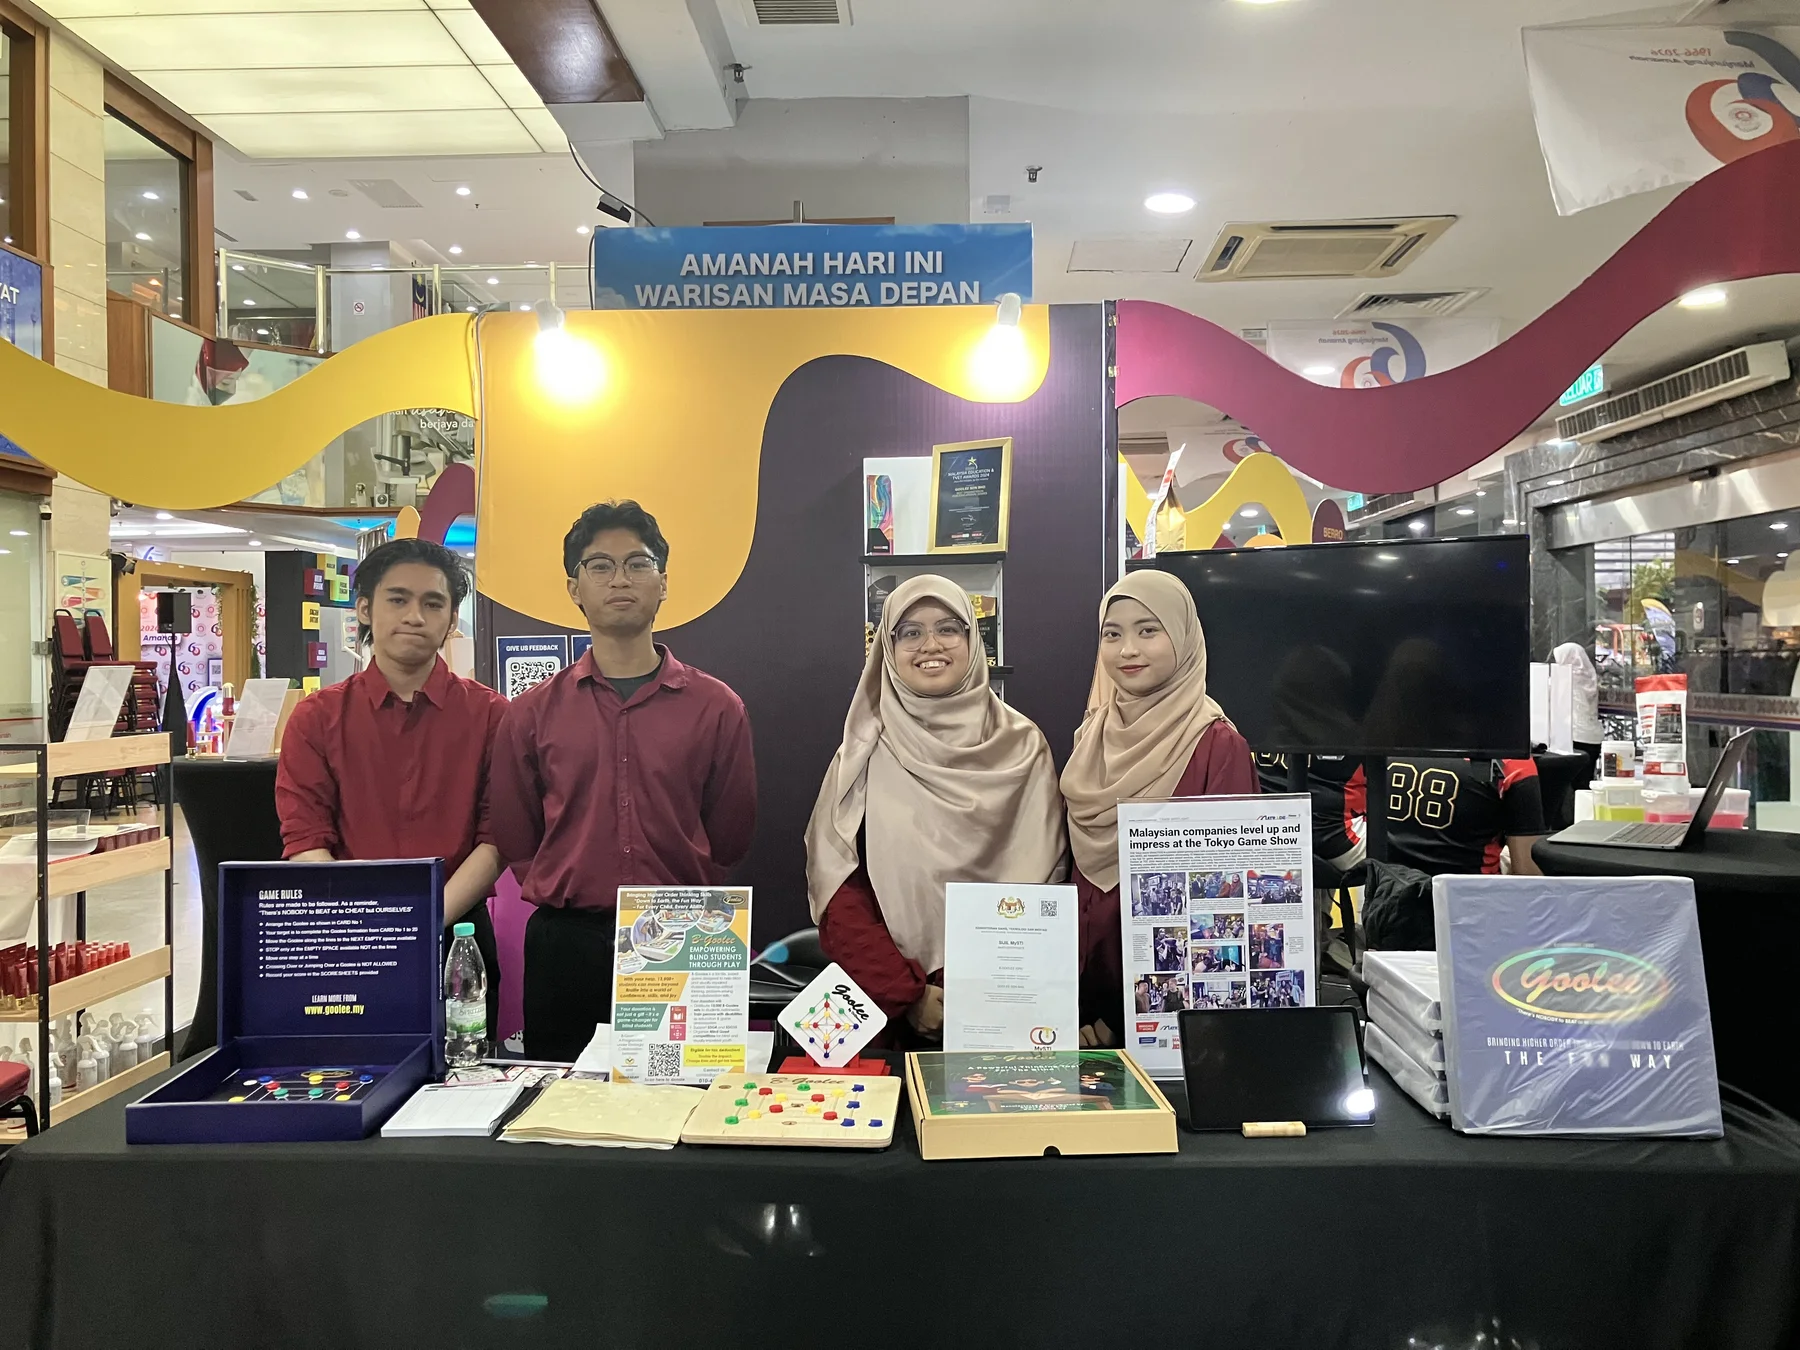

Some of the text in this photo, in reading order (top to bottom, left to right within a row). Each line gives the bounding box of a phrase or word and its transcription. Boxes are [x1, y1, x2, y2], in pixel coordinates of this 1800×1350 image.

[680, 251, 942, 276] AMANAH HARI INI
[635, 281, 980, 307] WARISAN MASA DEPAN
[420, 419, 458, 430] berjaya
[1387, 762, 1459, 829] 88
[1129, 824, 1300, 839] Malaysian companies level up and
[1130, 836, 1298, 850] impress at the Tokyo Game Show
[259, 890, 302, 899] GAME RULES
[312, 995, 327, 1003] LEARN
[343, 994, 356, 1002] FROM
[305, 1004, 364, 1015] www.goolee.my
[1487, 1037, 1520, 1047] BRINGING
[1522, 1038, 1547, 1048] HIGHER
[1505, 1051, 1543, 1065] THE
[1630, 1054, 1670, 1069] WAY
